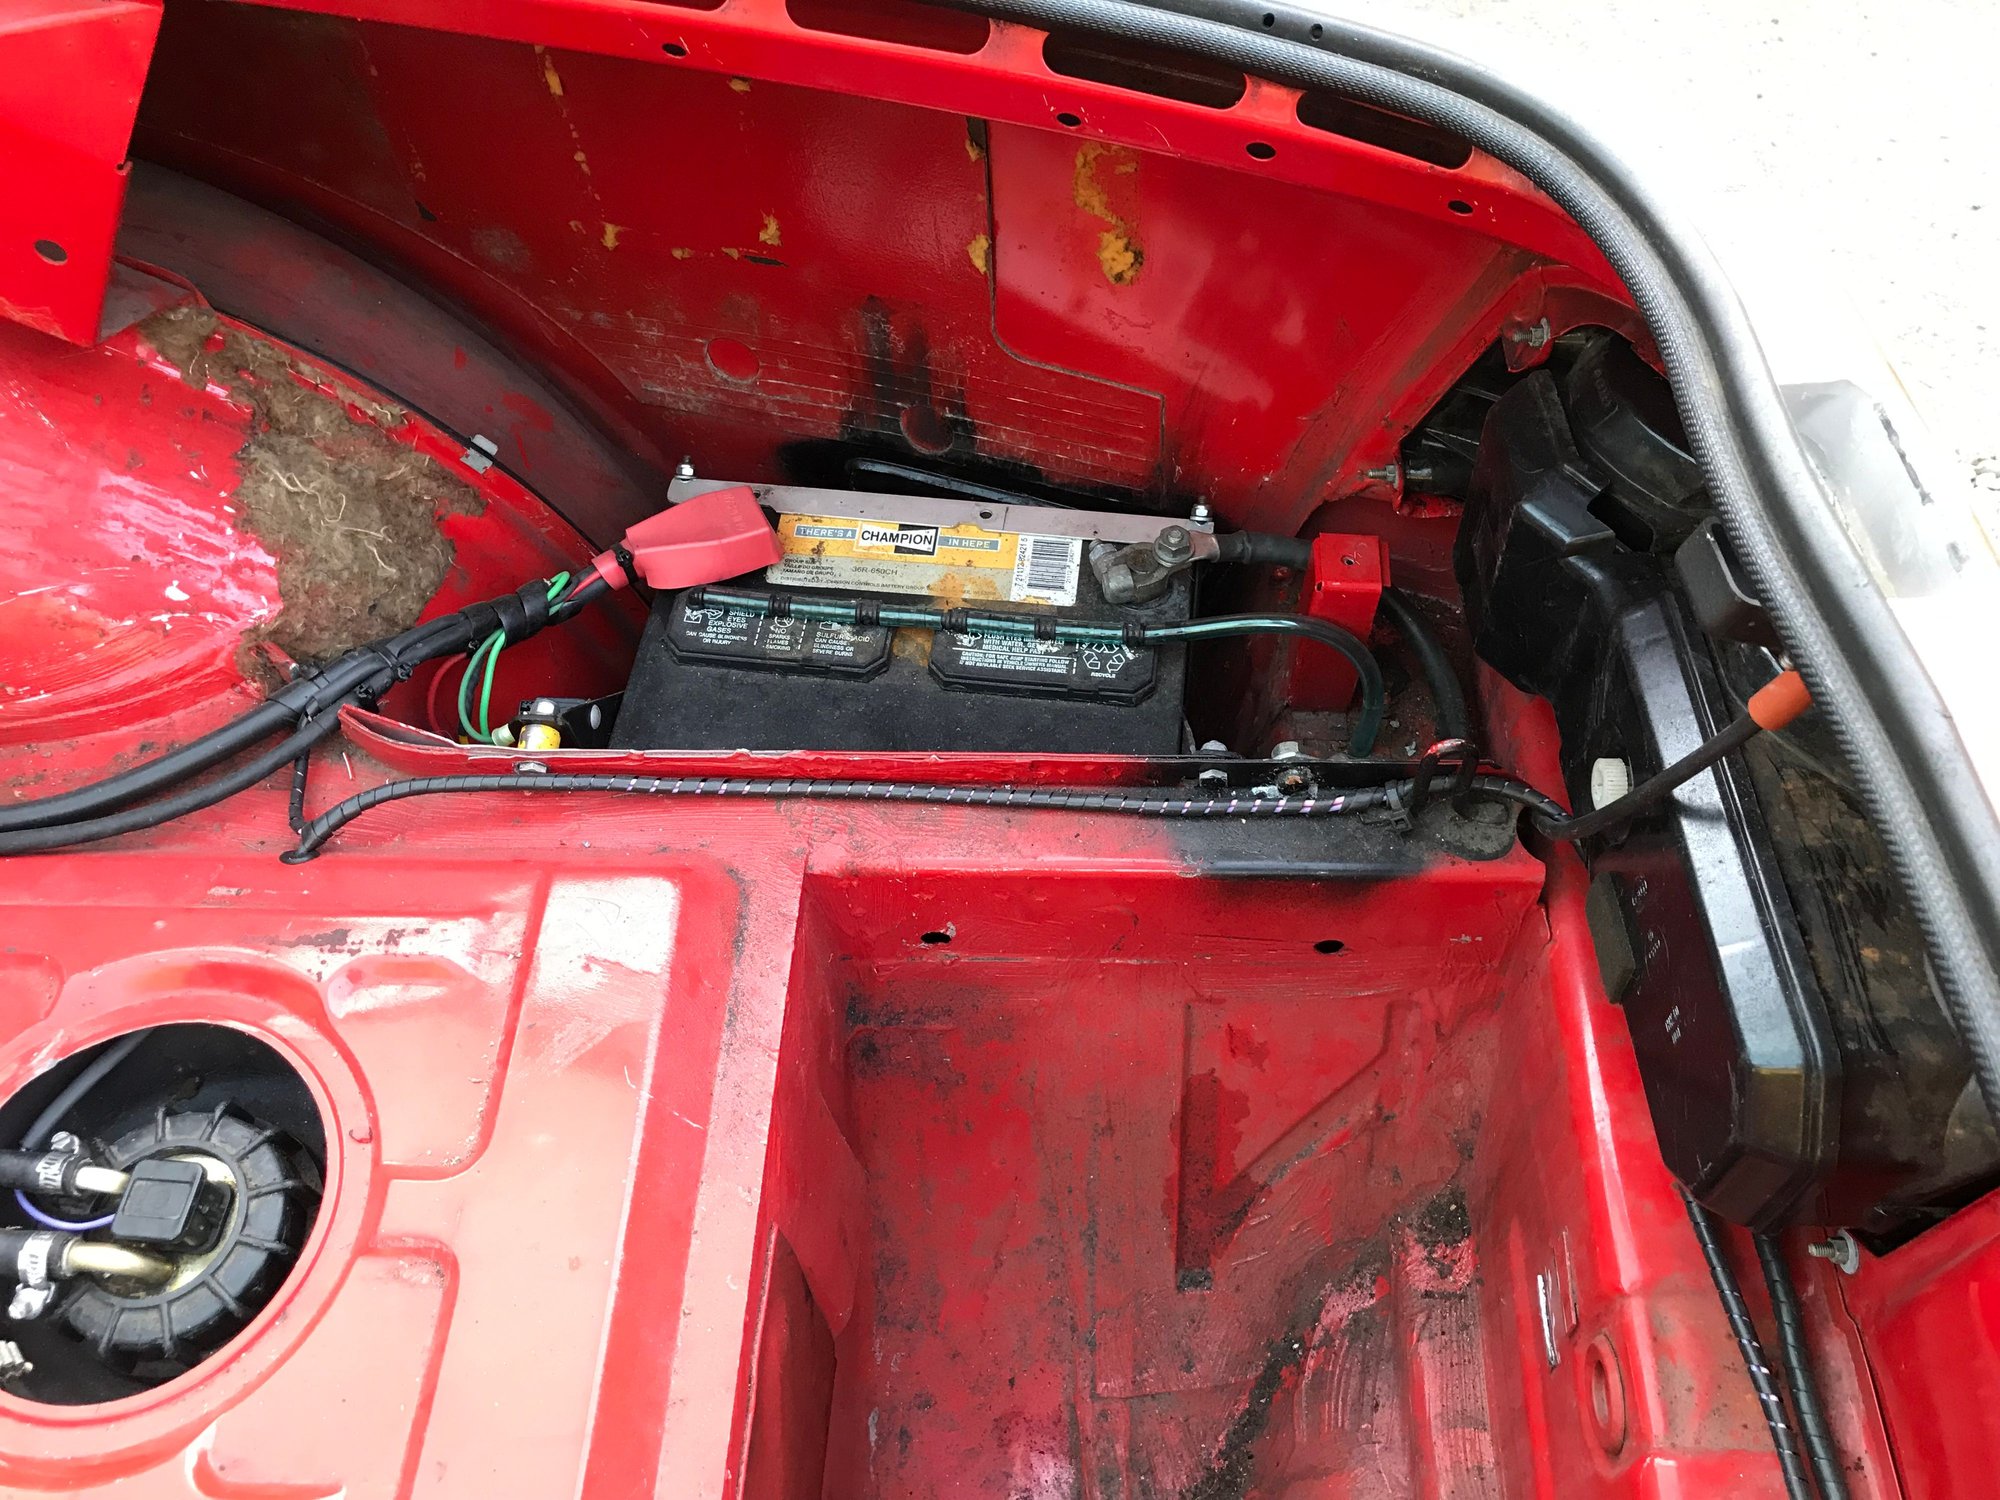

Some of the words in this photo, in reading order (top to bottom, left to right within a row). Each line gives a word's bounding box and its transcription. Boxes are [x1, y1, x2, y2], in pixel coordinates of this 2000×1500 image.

[800, 527, 844, 538] THERE'S
[846, 528, 852, 539] A
[861, 530, 933, 545] CHAMPION
[949, 538, 960, 546] IN
[851, 566, 898, 575] 36R-650CH
[1016, 563, 1024, 582] 21112
[708, 620, 748, 629] EXPLOSIVE
